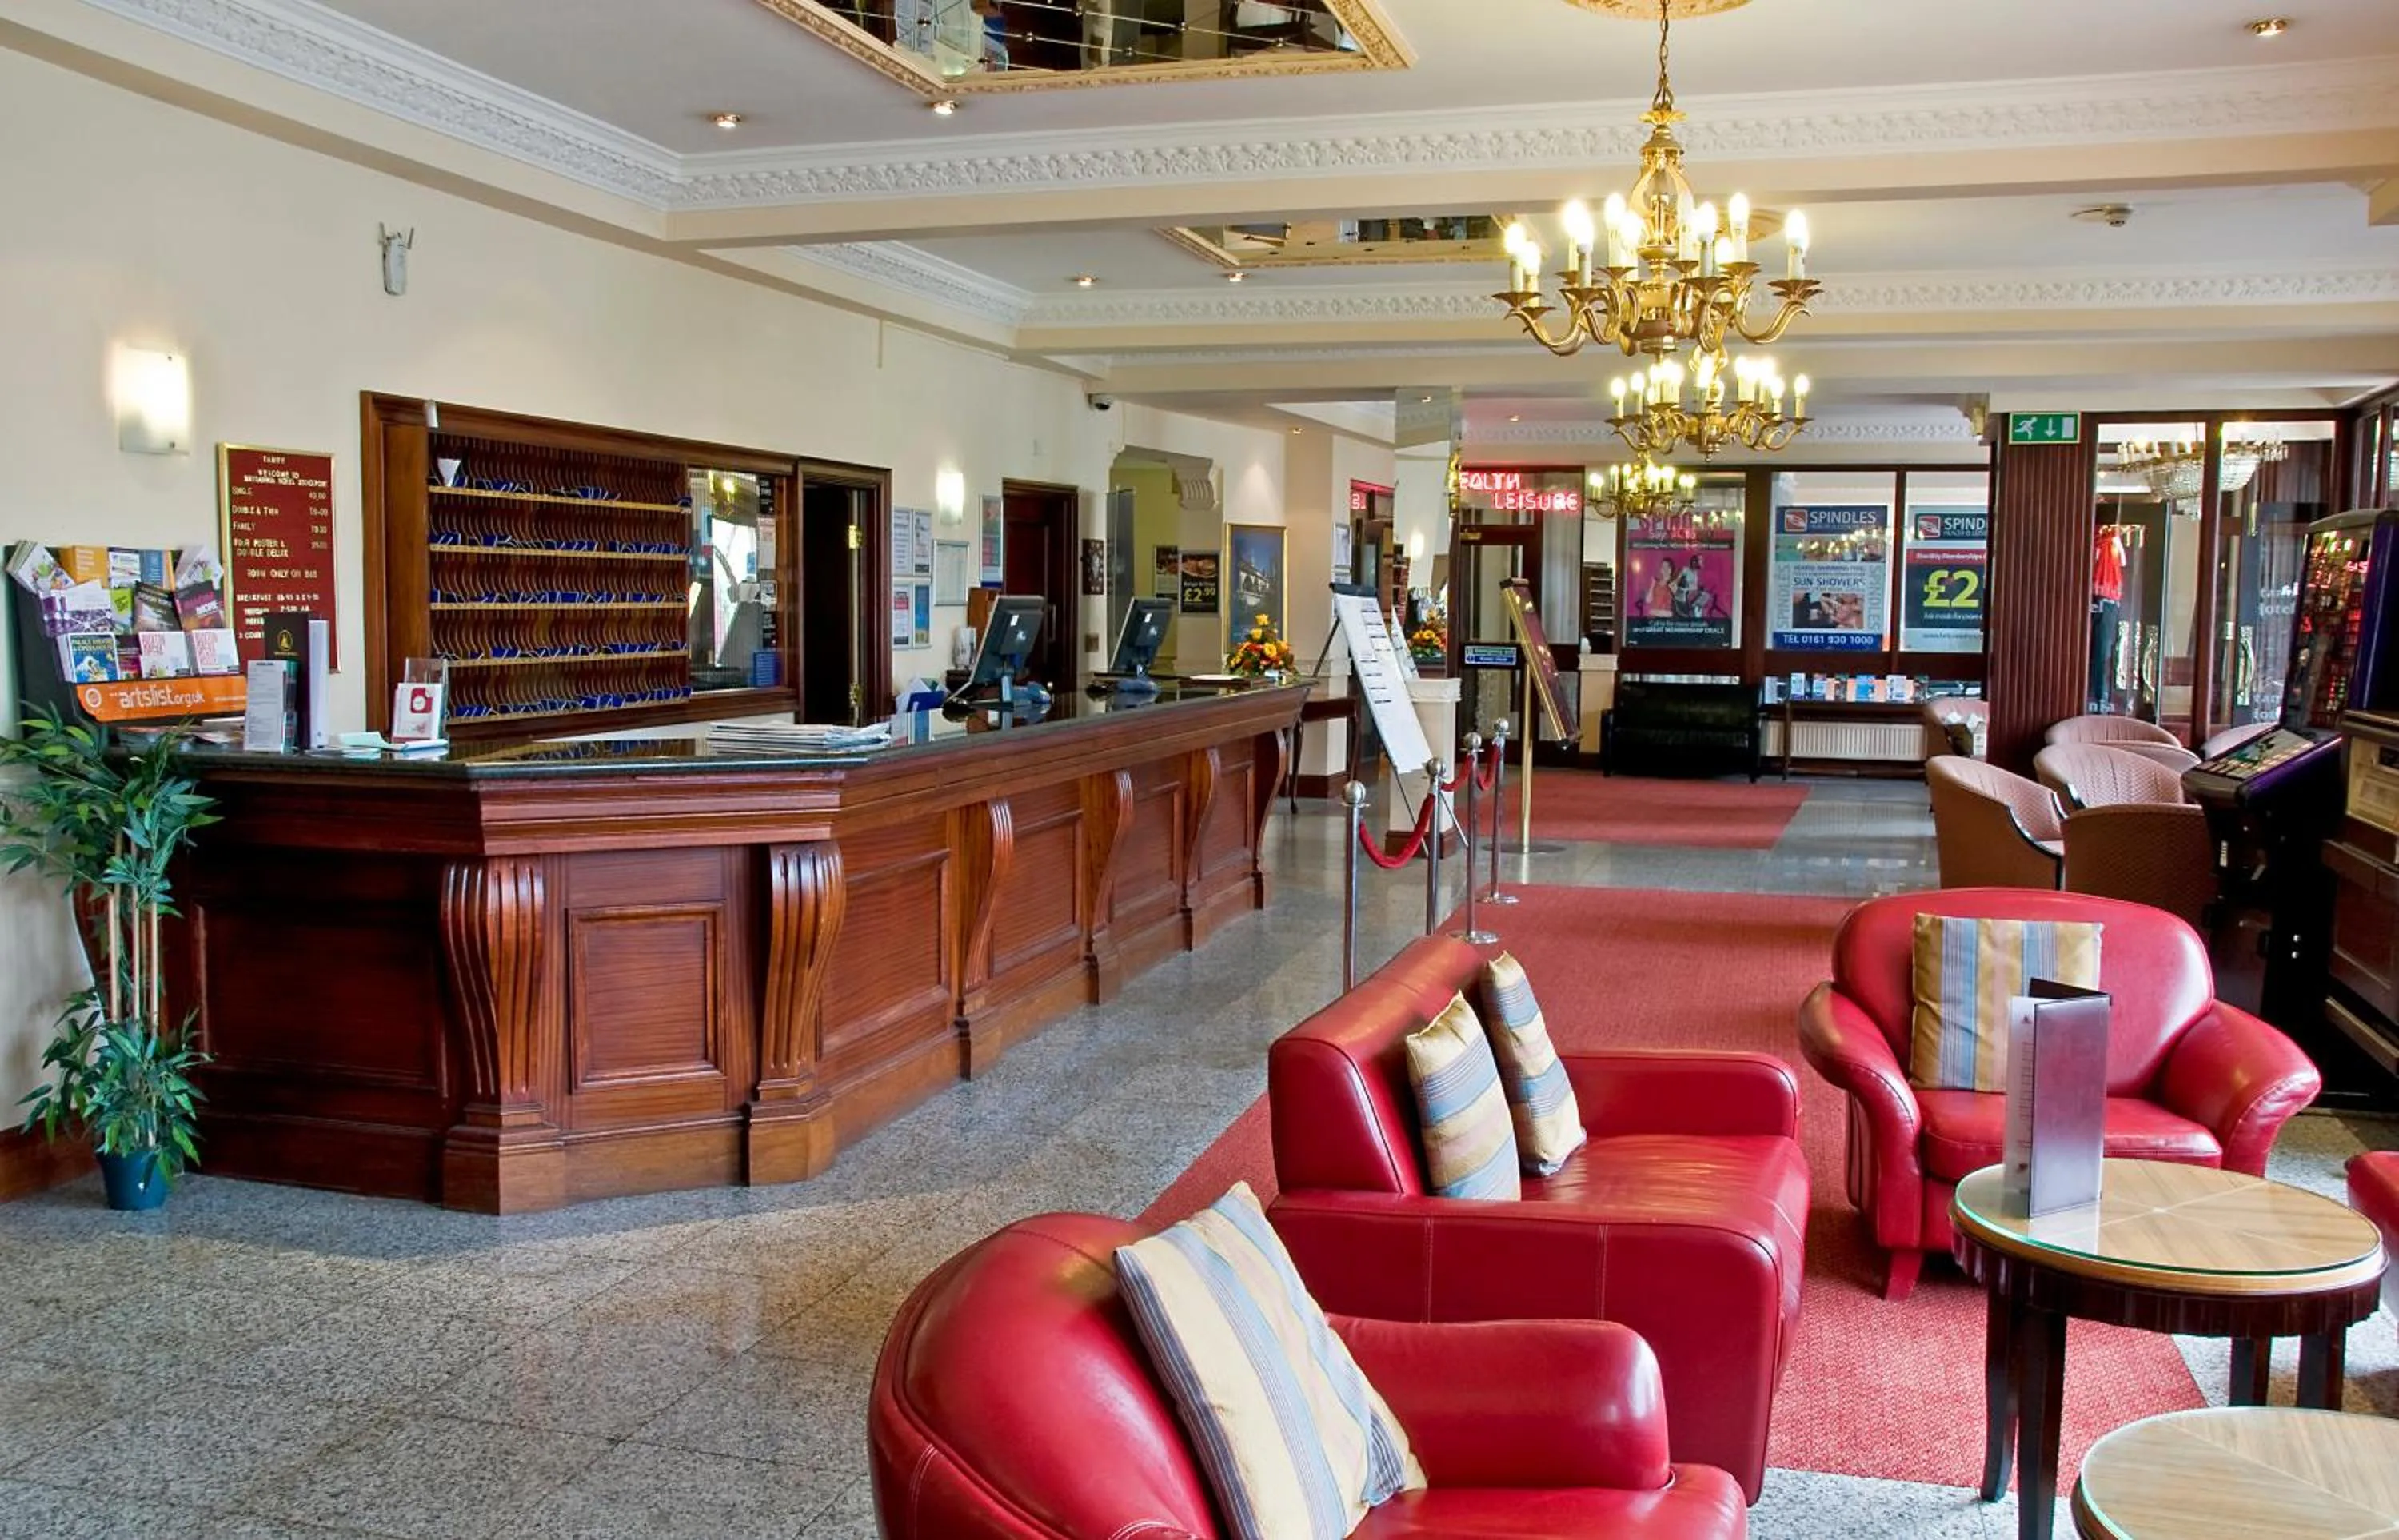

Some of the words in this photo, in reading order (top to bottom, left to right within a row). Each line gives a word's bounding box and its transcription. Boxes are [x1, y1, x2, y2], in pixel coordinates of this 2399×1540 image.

[1459, 472, 1521, 490] EALTH
[1494, 492, 1579, 511] LEISURE
[1809, 511, 1878, 525] SPINDLES
[1944, 517, 1986, 530] SPIND
[1783, 635, 1799, 644] TEL
[1802, 635, 1824, 644] 0161
[1850, 635, 1874, 645] 1000
